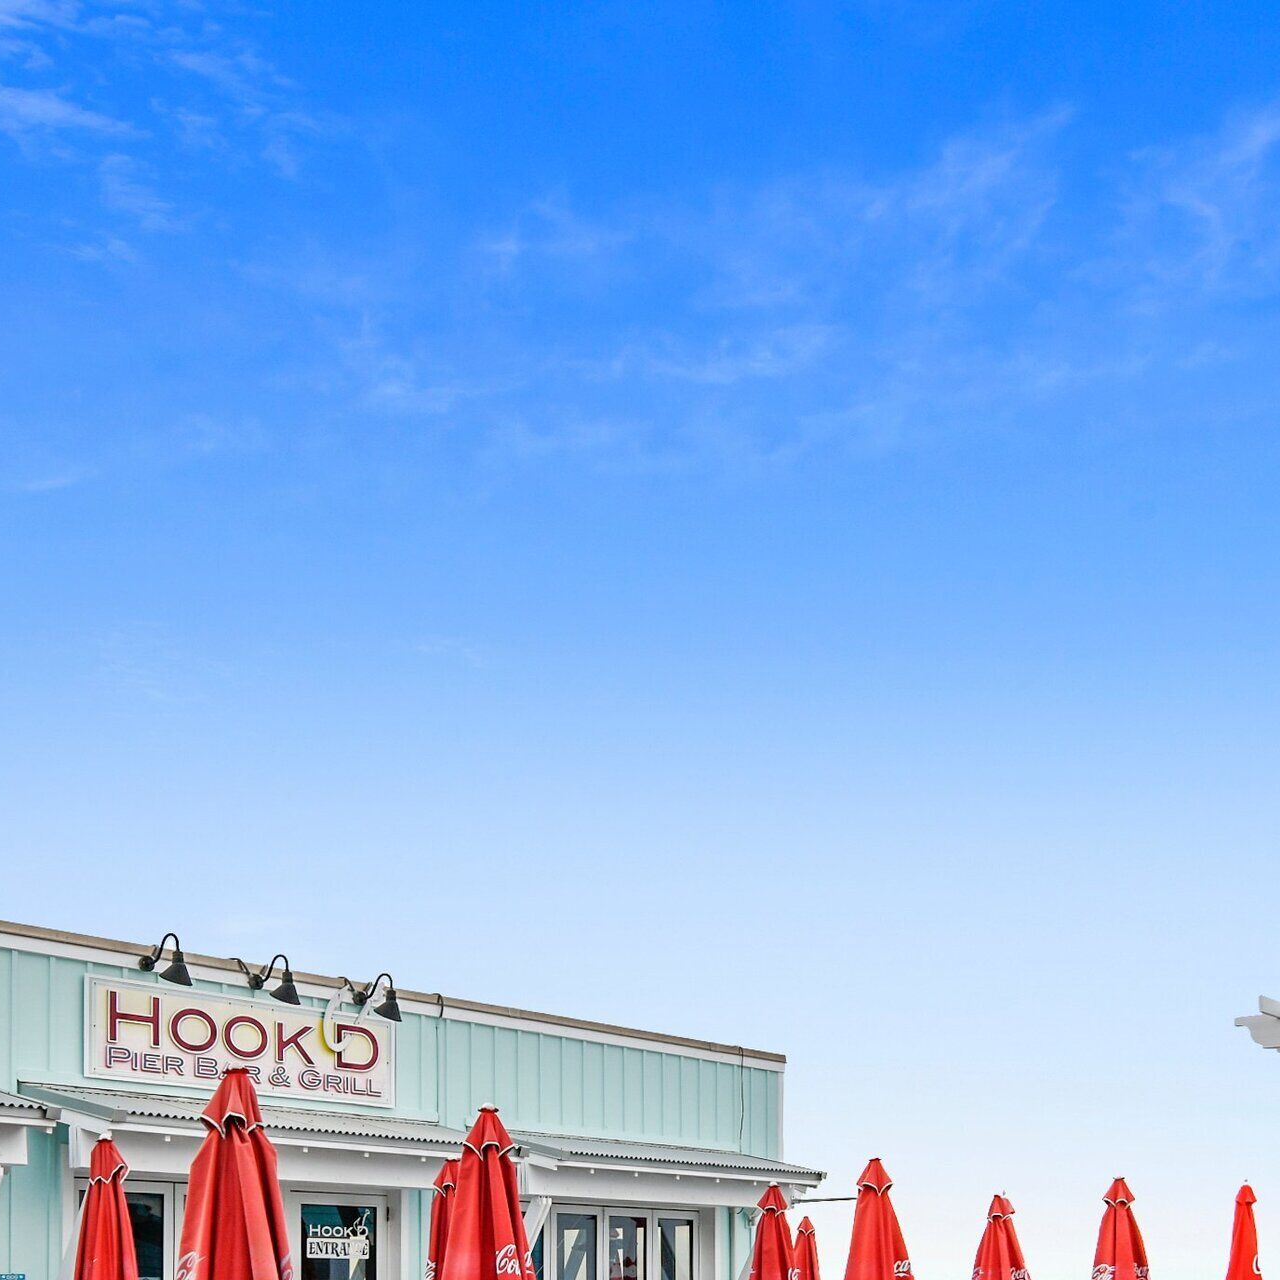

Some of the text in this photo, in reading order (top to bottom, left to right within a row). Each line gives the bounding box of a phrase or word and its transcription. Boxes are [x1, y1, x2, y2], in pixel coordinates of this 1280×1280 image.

[106, 1044, 185, 1076] PIER
[270, 1066, 291, 1087] &
[299, 1069, 383, 1098] GRILL
[308, 1241, 369, 1258] ENTRAE
